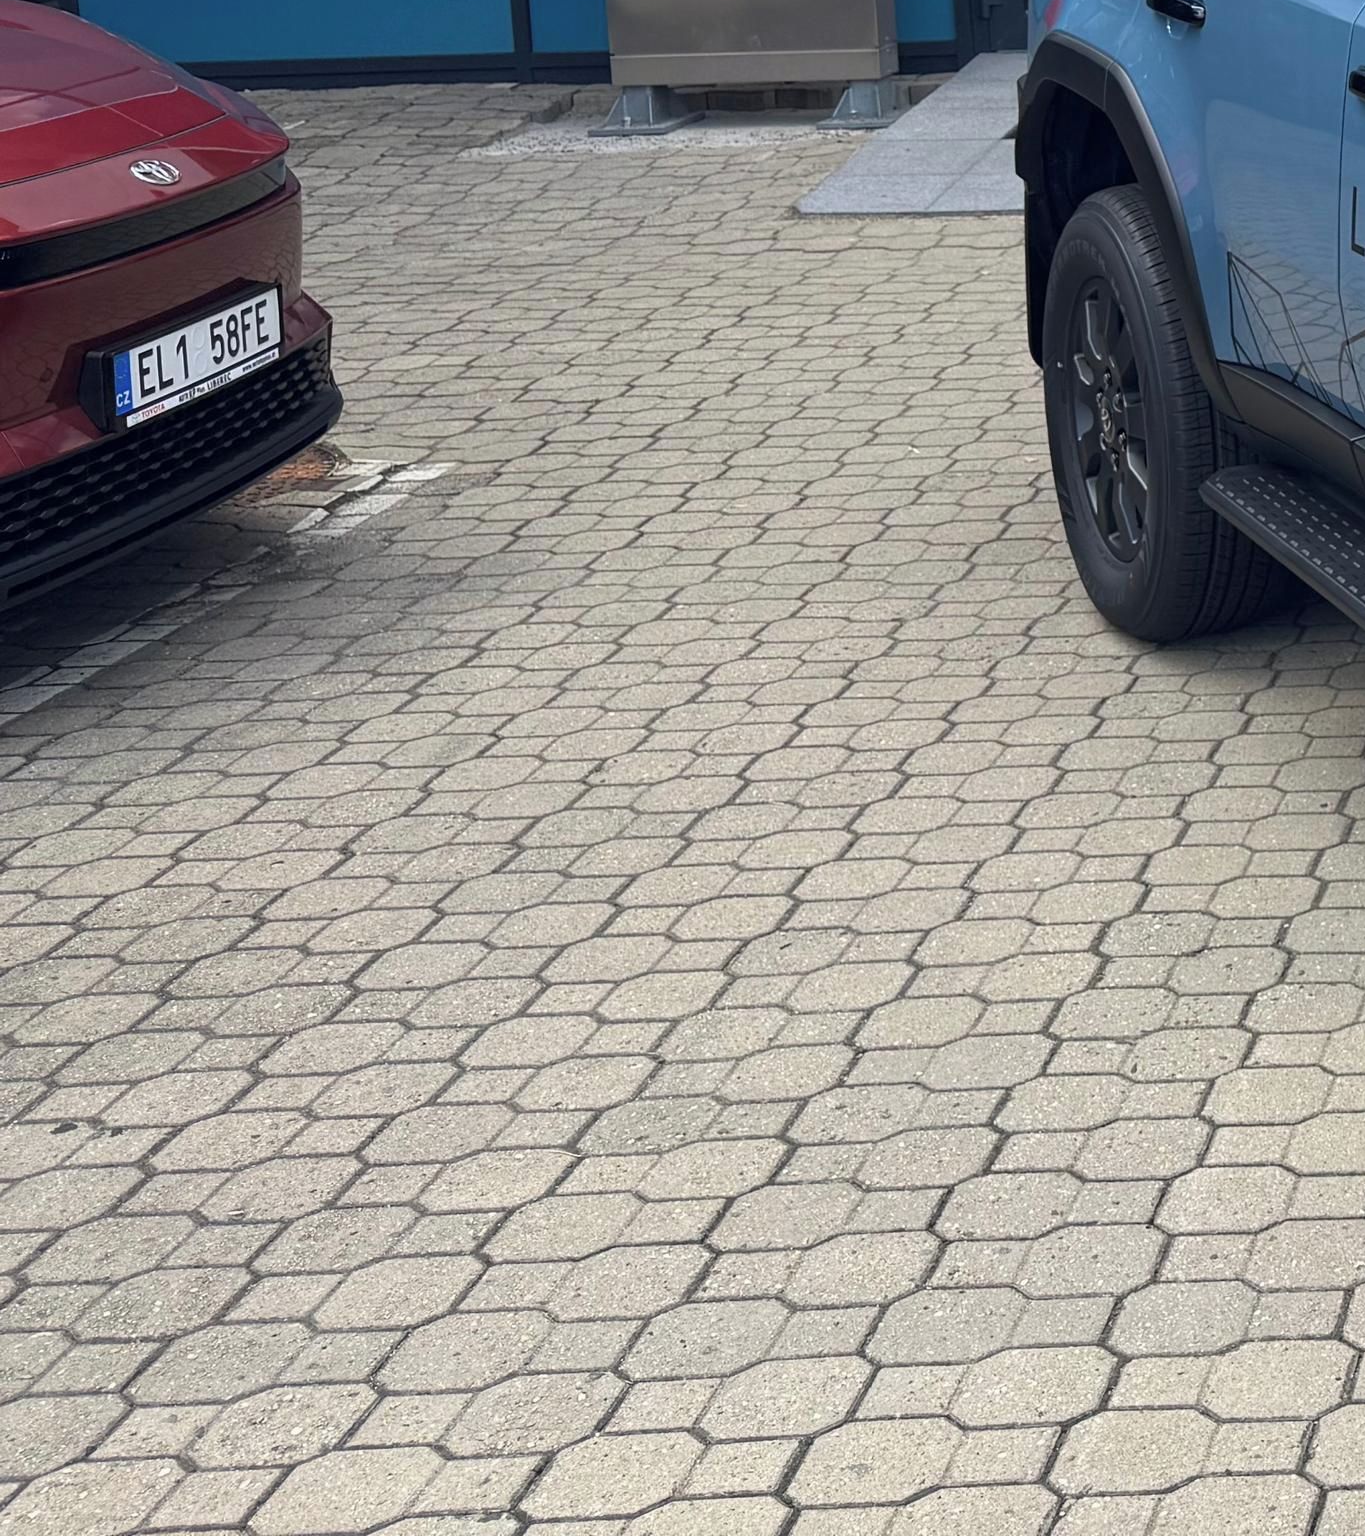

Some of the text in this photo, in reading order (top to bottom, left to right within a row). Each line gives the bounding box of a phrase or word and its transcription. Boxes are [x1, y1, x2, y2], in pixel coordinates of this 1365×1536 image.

[138, 299, 270, 399] EL1 58FE
[116, 390, 131, 408] CZ
